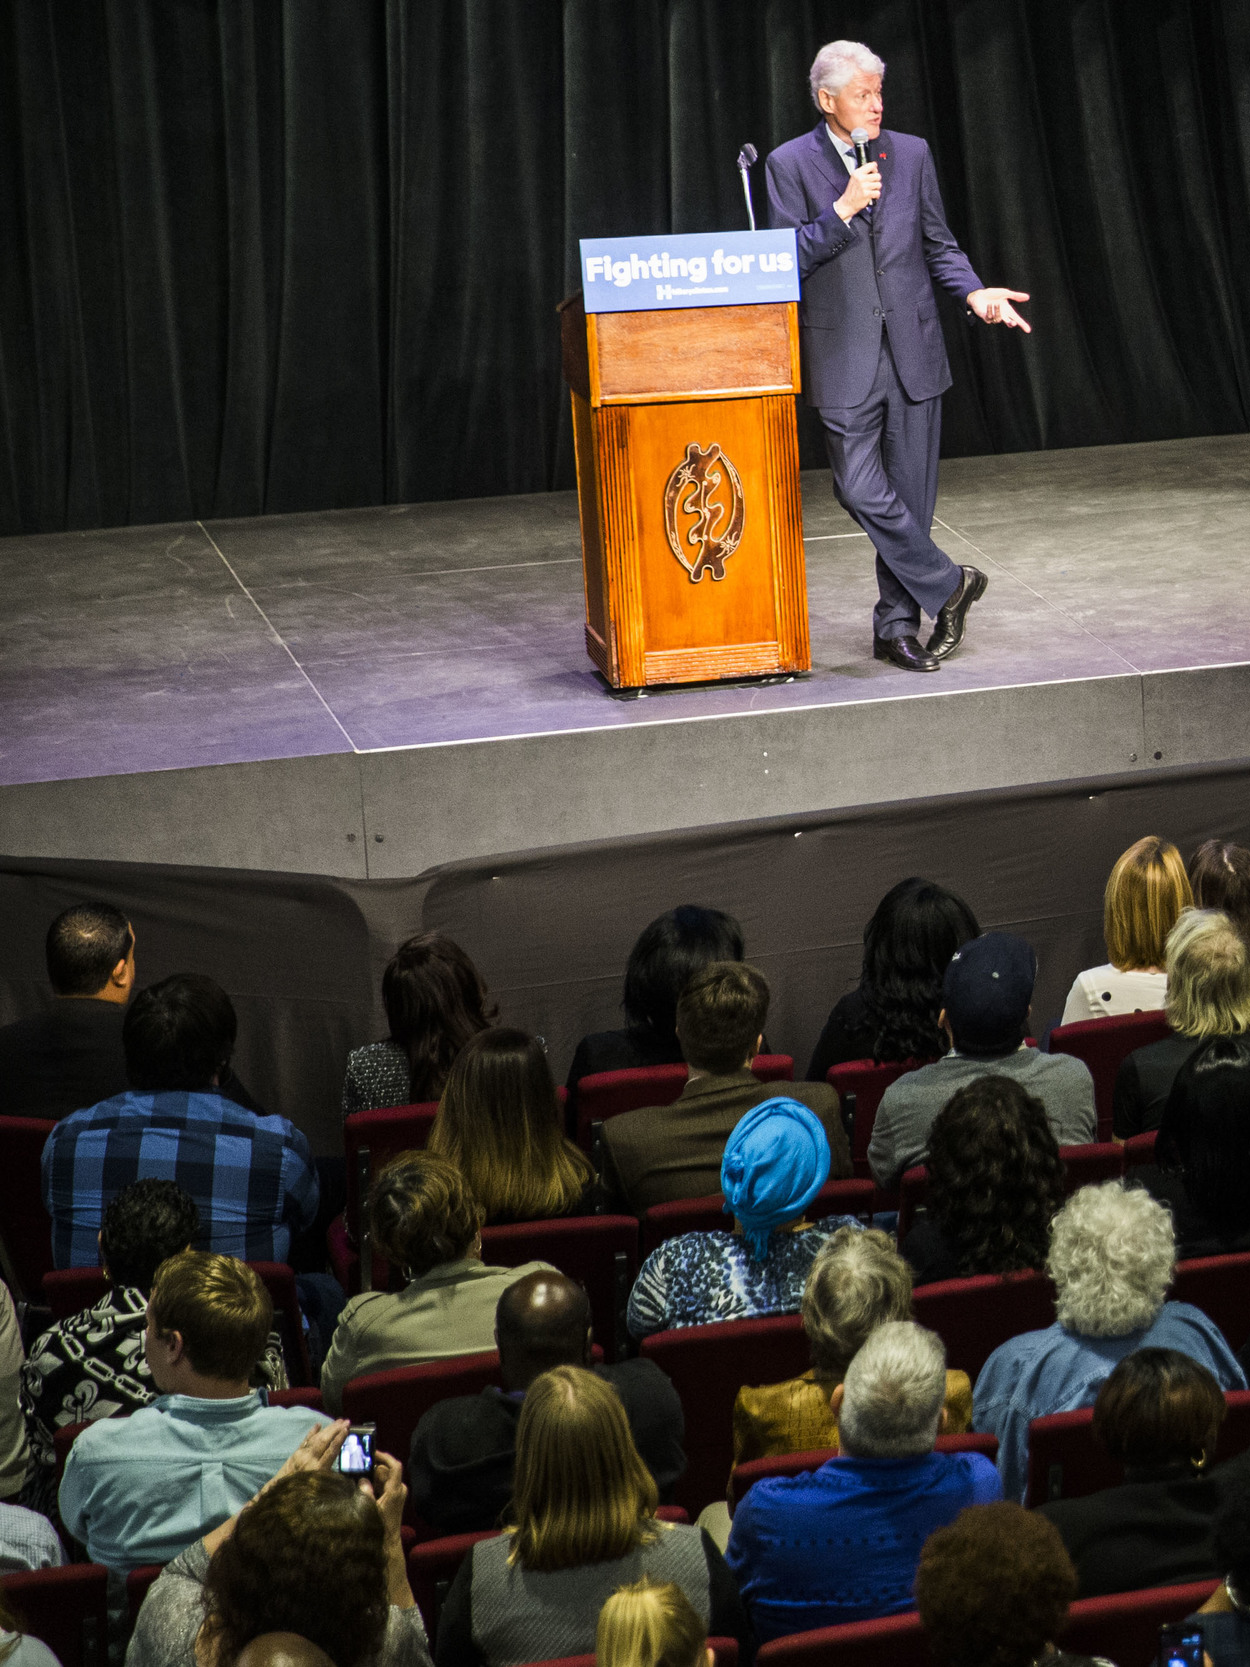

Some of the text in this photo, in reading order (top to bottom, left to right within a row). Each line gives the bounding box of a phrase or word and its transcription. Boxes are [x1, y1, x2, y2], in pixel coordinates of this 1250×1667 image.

[585, 248, 794, 288] Fighting for us
